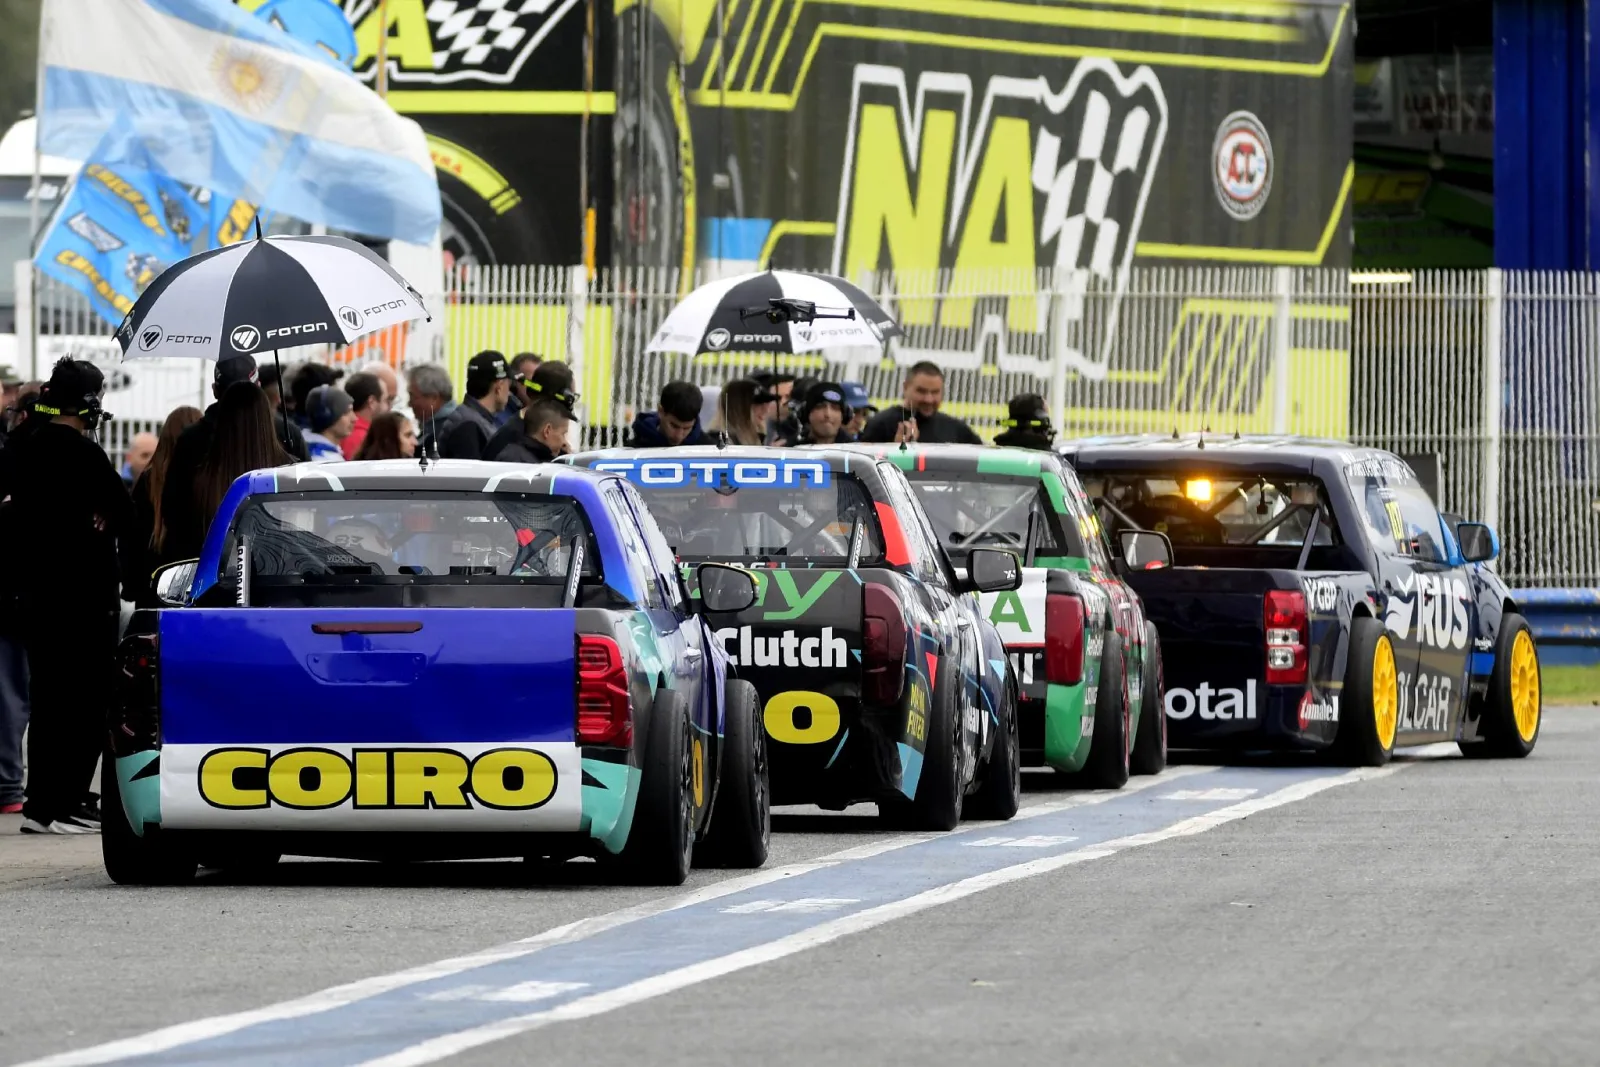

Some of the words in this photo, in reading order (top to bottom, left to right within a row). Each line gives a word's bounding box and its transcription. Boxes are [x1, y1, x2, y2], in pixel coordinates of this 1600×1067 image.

[364, 299, 407, 317] FOTON
[267, 321, 328, 339] FOTON
[733, 333, 783, 344] FOTON
[820, 328, 864, 337] FOTON
[166, 334, 212, 345] FOTON
[595, 462, 823, 484] FOTON
[721, 625, 848, 668] Clutch
[197, 746, 559, 811] COIRO
